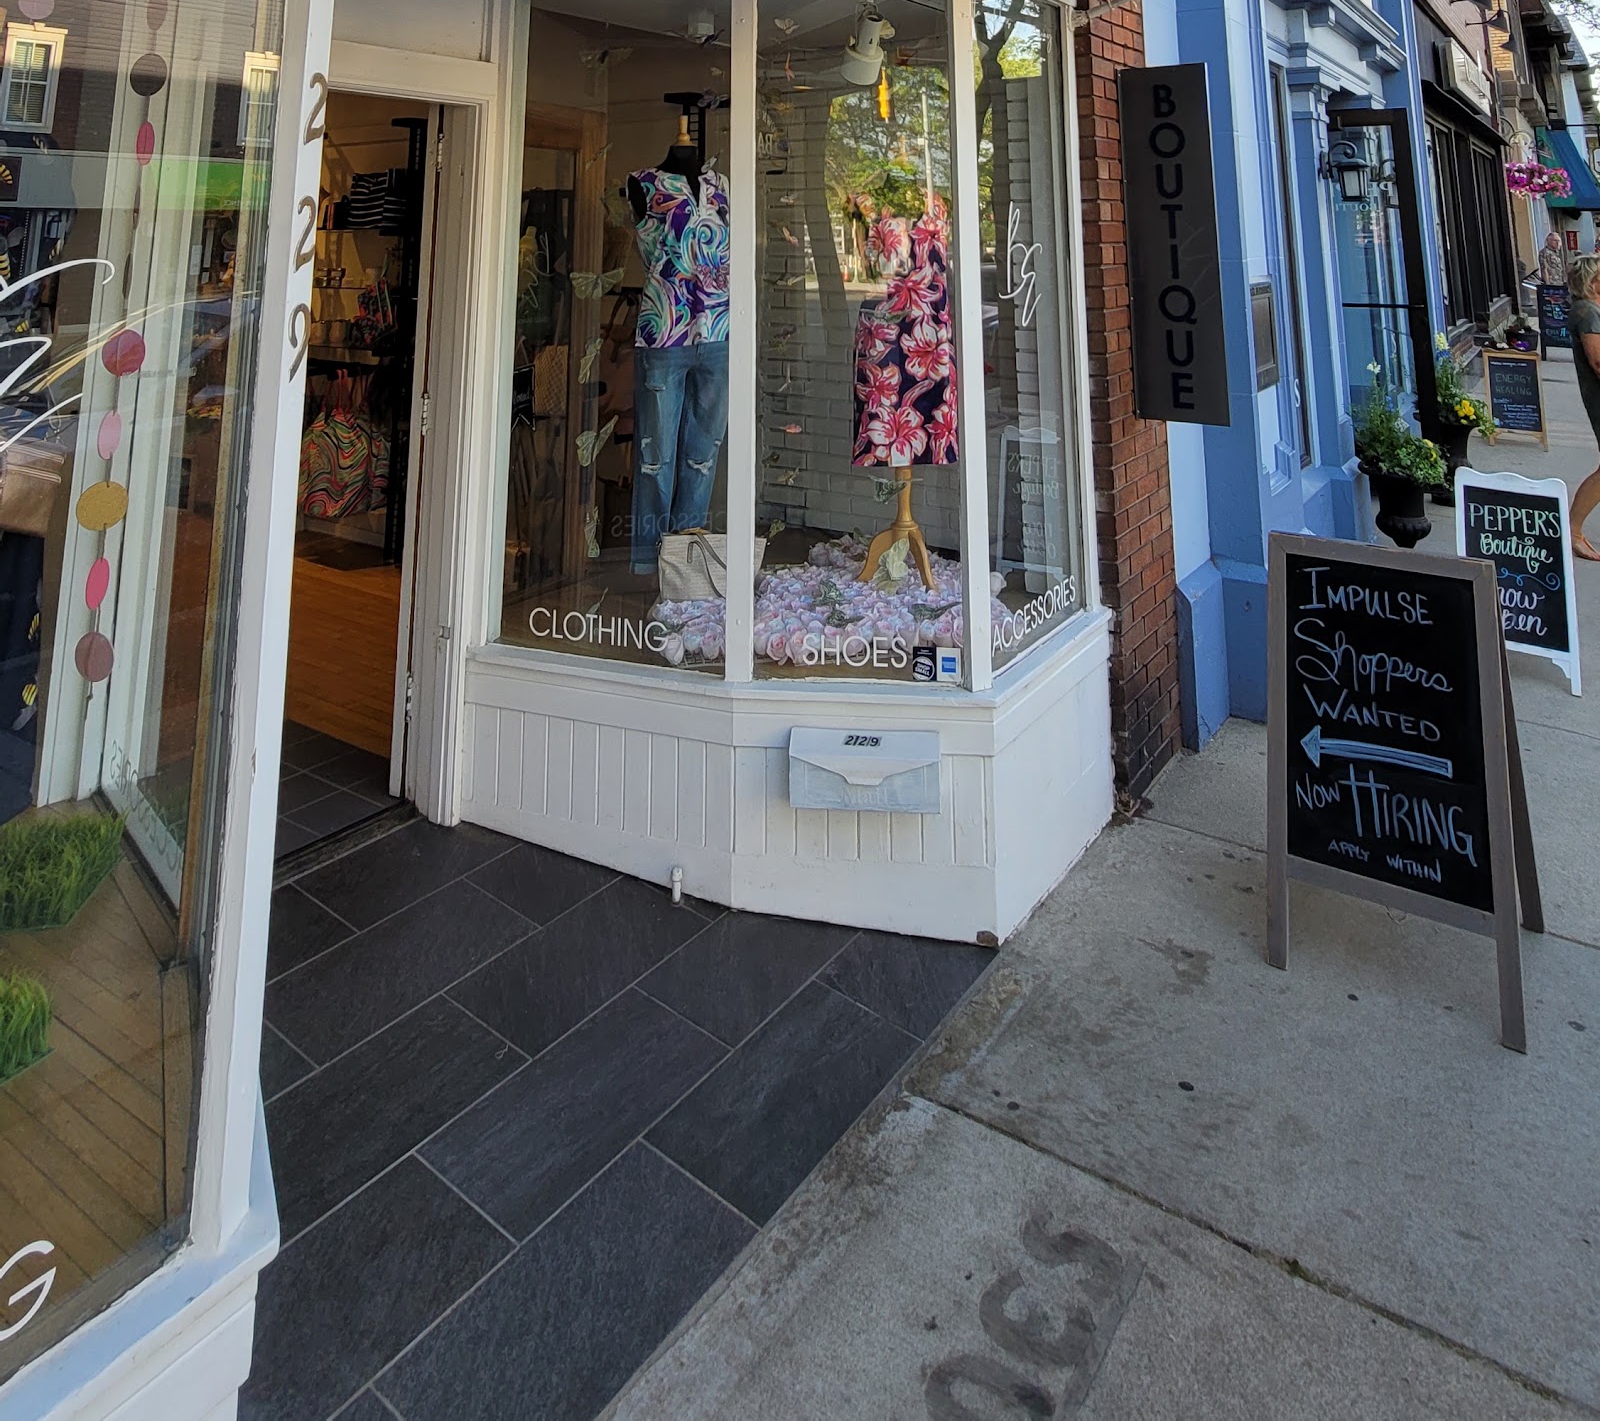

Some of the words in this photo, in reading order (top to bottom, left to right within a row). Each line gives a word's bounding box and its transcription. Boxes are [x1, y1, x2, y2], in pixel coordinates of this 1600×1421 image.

[1148, 83, 1198, 411] BOUTIQUE
[1468, 502, 1561, 538] PEPPER'S
[1480, 533, 1554, 574] Boutique
[528, 607, 670, 652] CLOTHING
[991, 576, 1076, 658] ACCESSORIES
[1502, 609, 1548, 636] pen
[802, 635, 908, 670] SHOES
[1294, 617, 1454, 695] Shoppers
[1303, 683, 1441, 743] WANTED
[1328, 838, 1371, 863] APPLY
[1386, 854, 1442, 884] WITHIN
